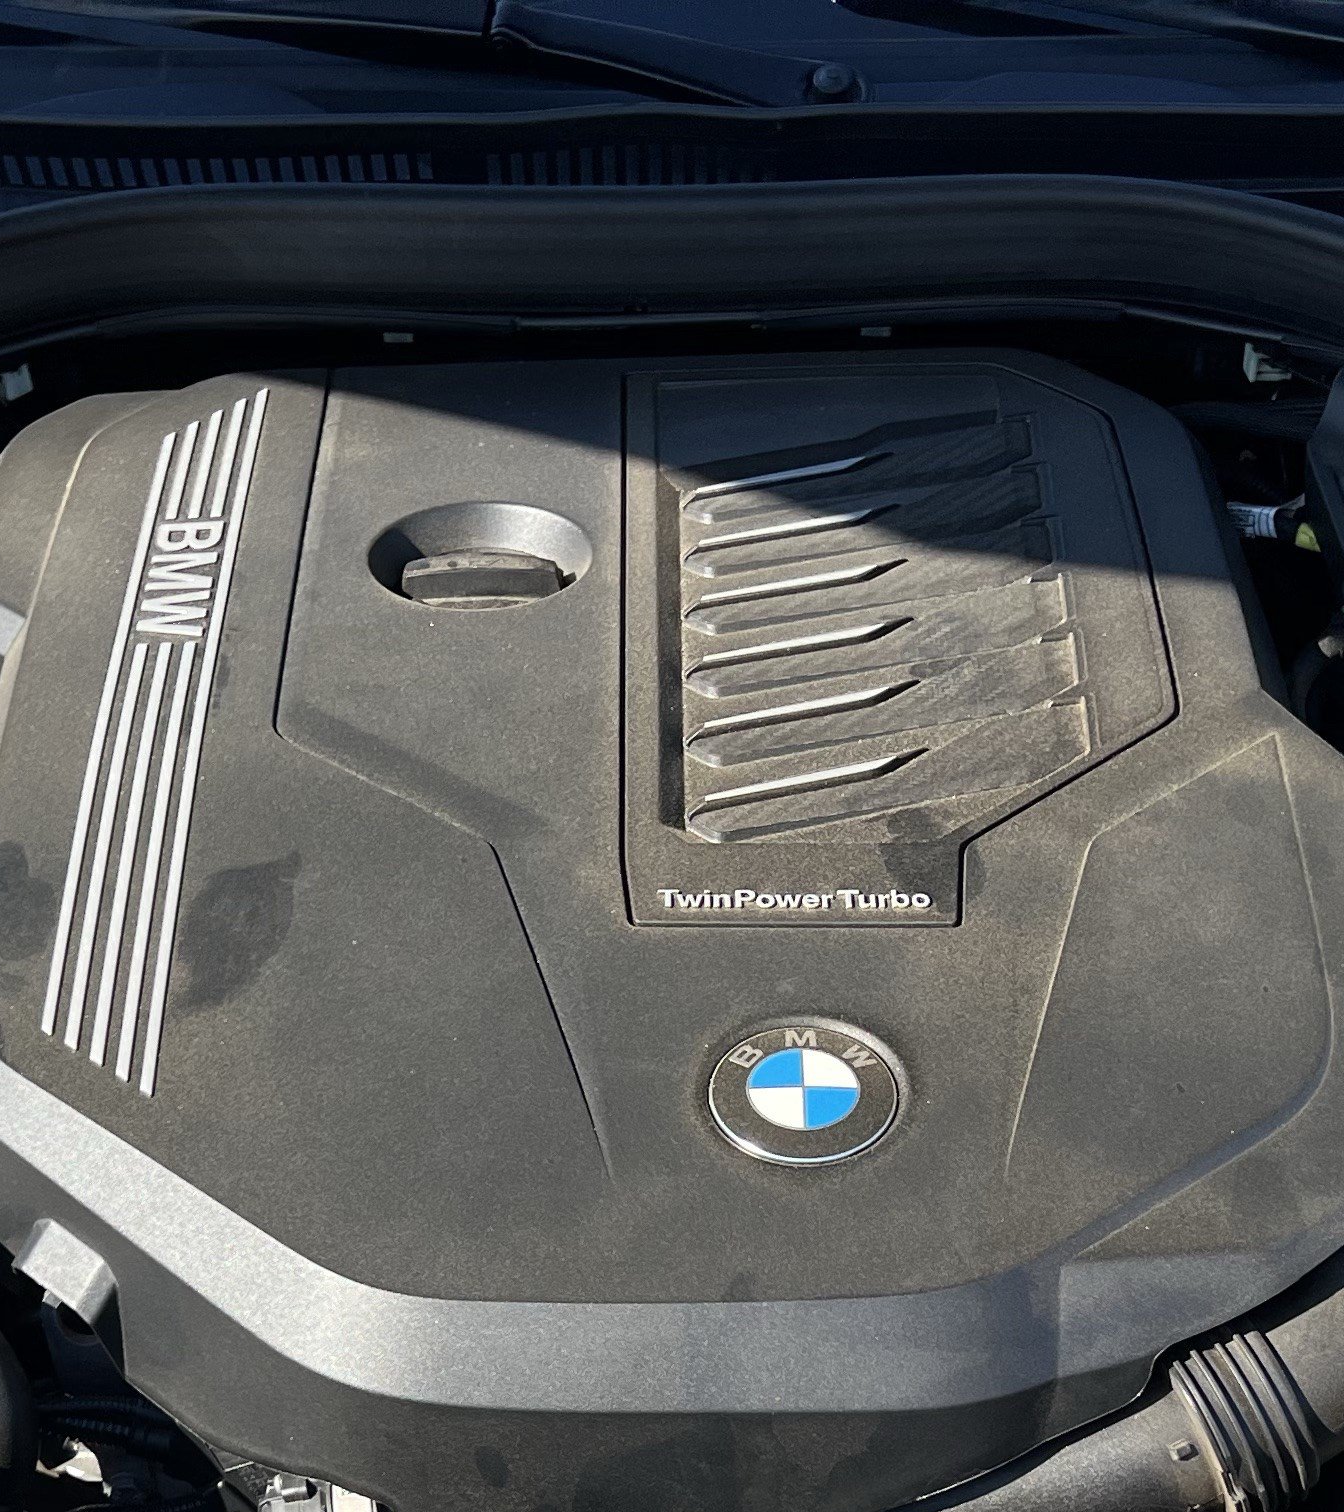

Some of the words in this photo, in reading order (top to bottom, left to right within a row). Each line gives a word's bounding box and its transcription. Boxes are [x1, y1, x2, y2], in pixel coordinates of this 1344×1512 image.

[136, 520, 225, 637] BMW
[657, 889, 835, 909] TwinPower
[837, 889, 932, 909] Turbo
